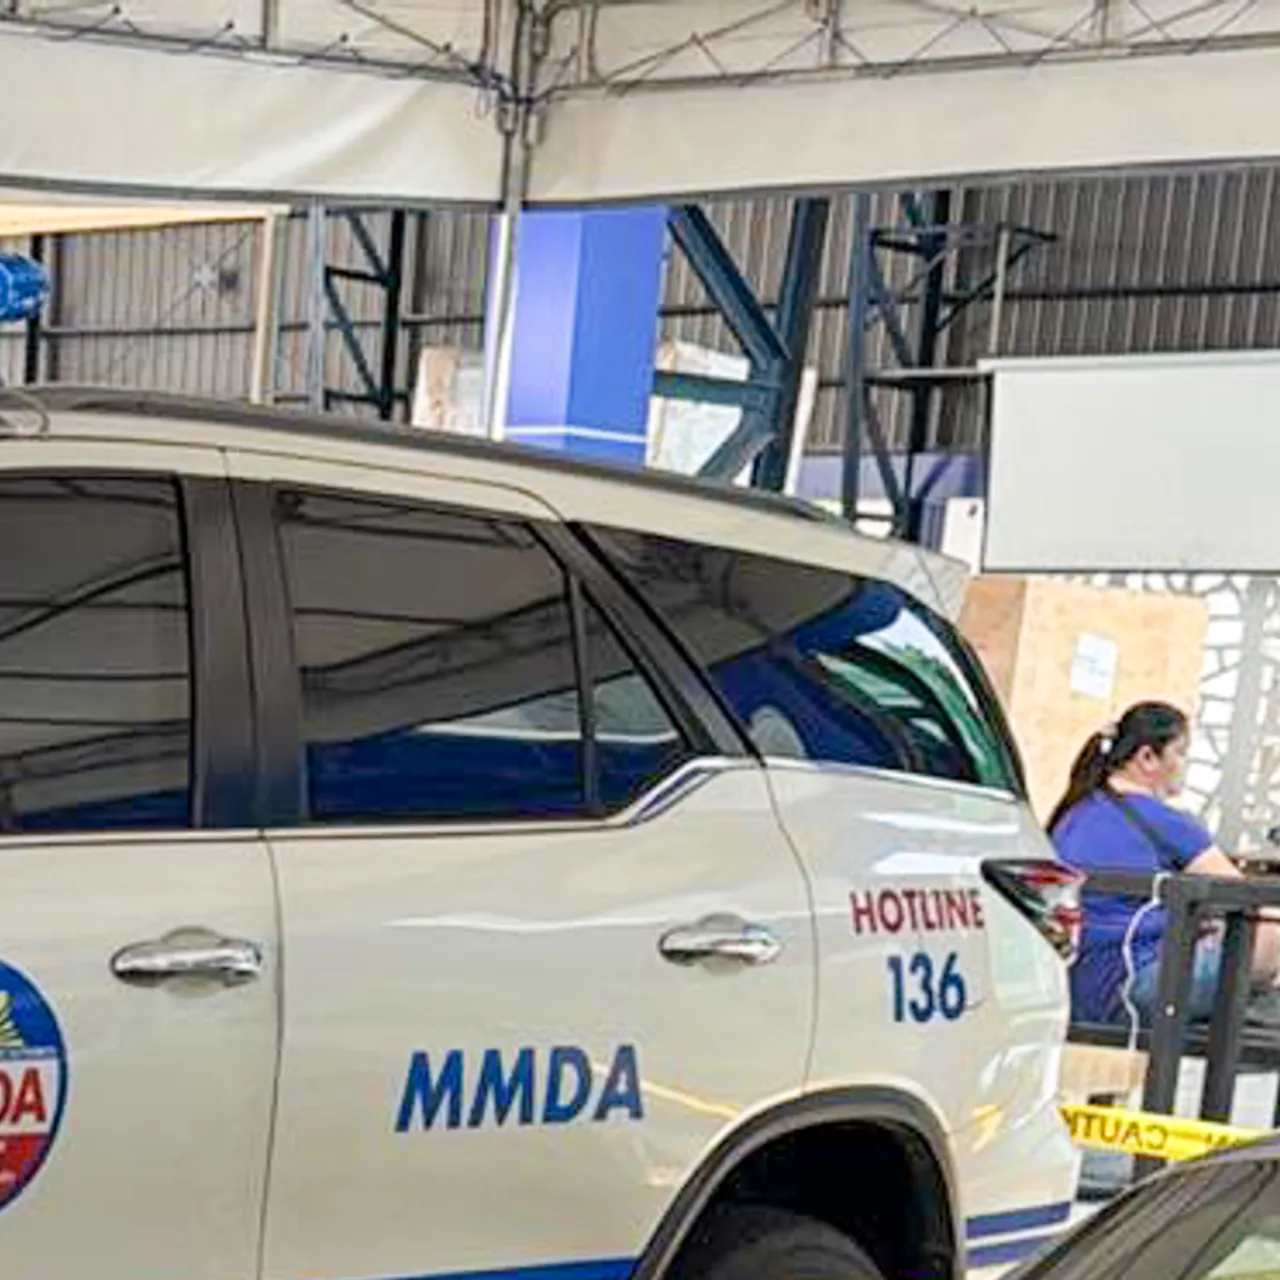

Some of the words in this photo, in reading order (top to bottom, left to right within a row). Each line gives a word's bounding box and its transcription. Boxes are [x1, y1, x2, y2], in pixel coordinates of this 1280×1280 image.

[849, 889, 985, 933] HOTLINE
[888, 952, 966, 1022] 136
[395, 1045, 643, 1132] MMDA
